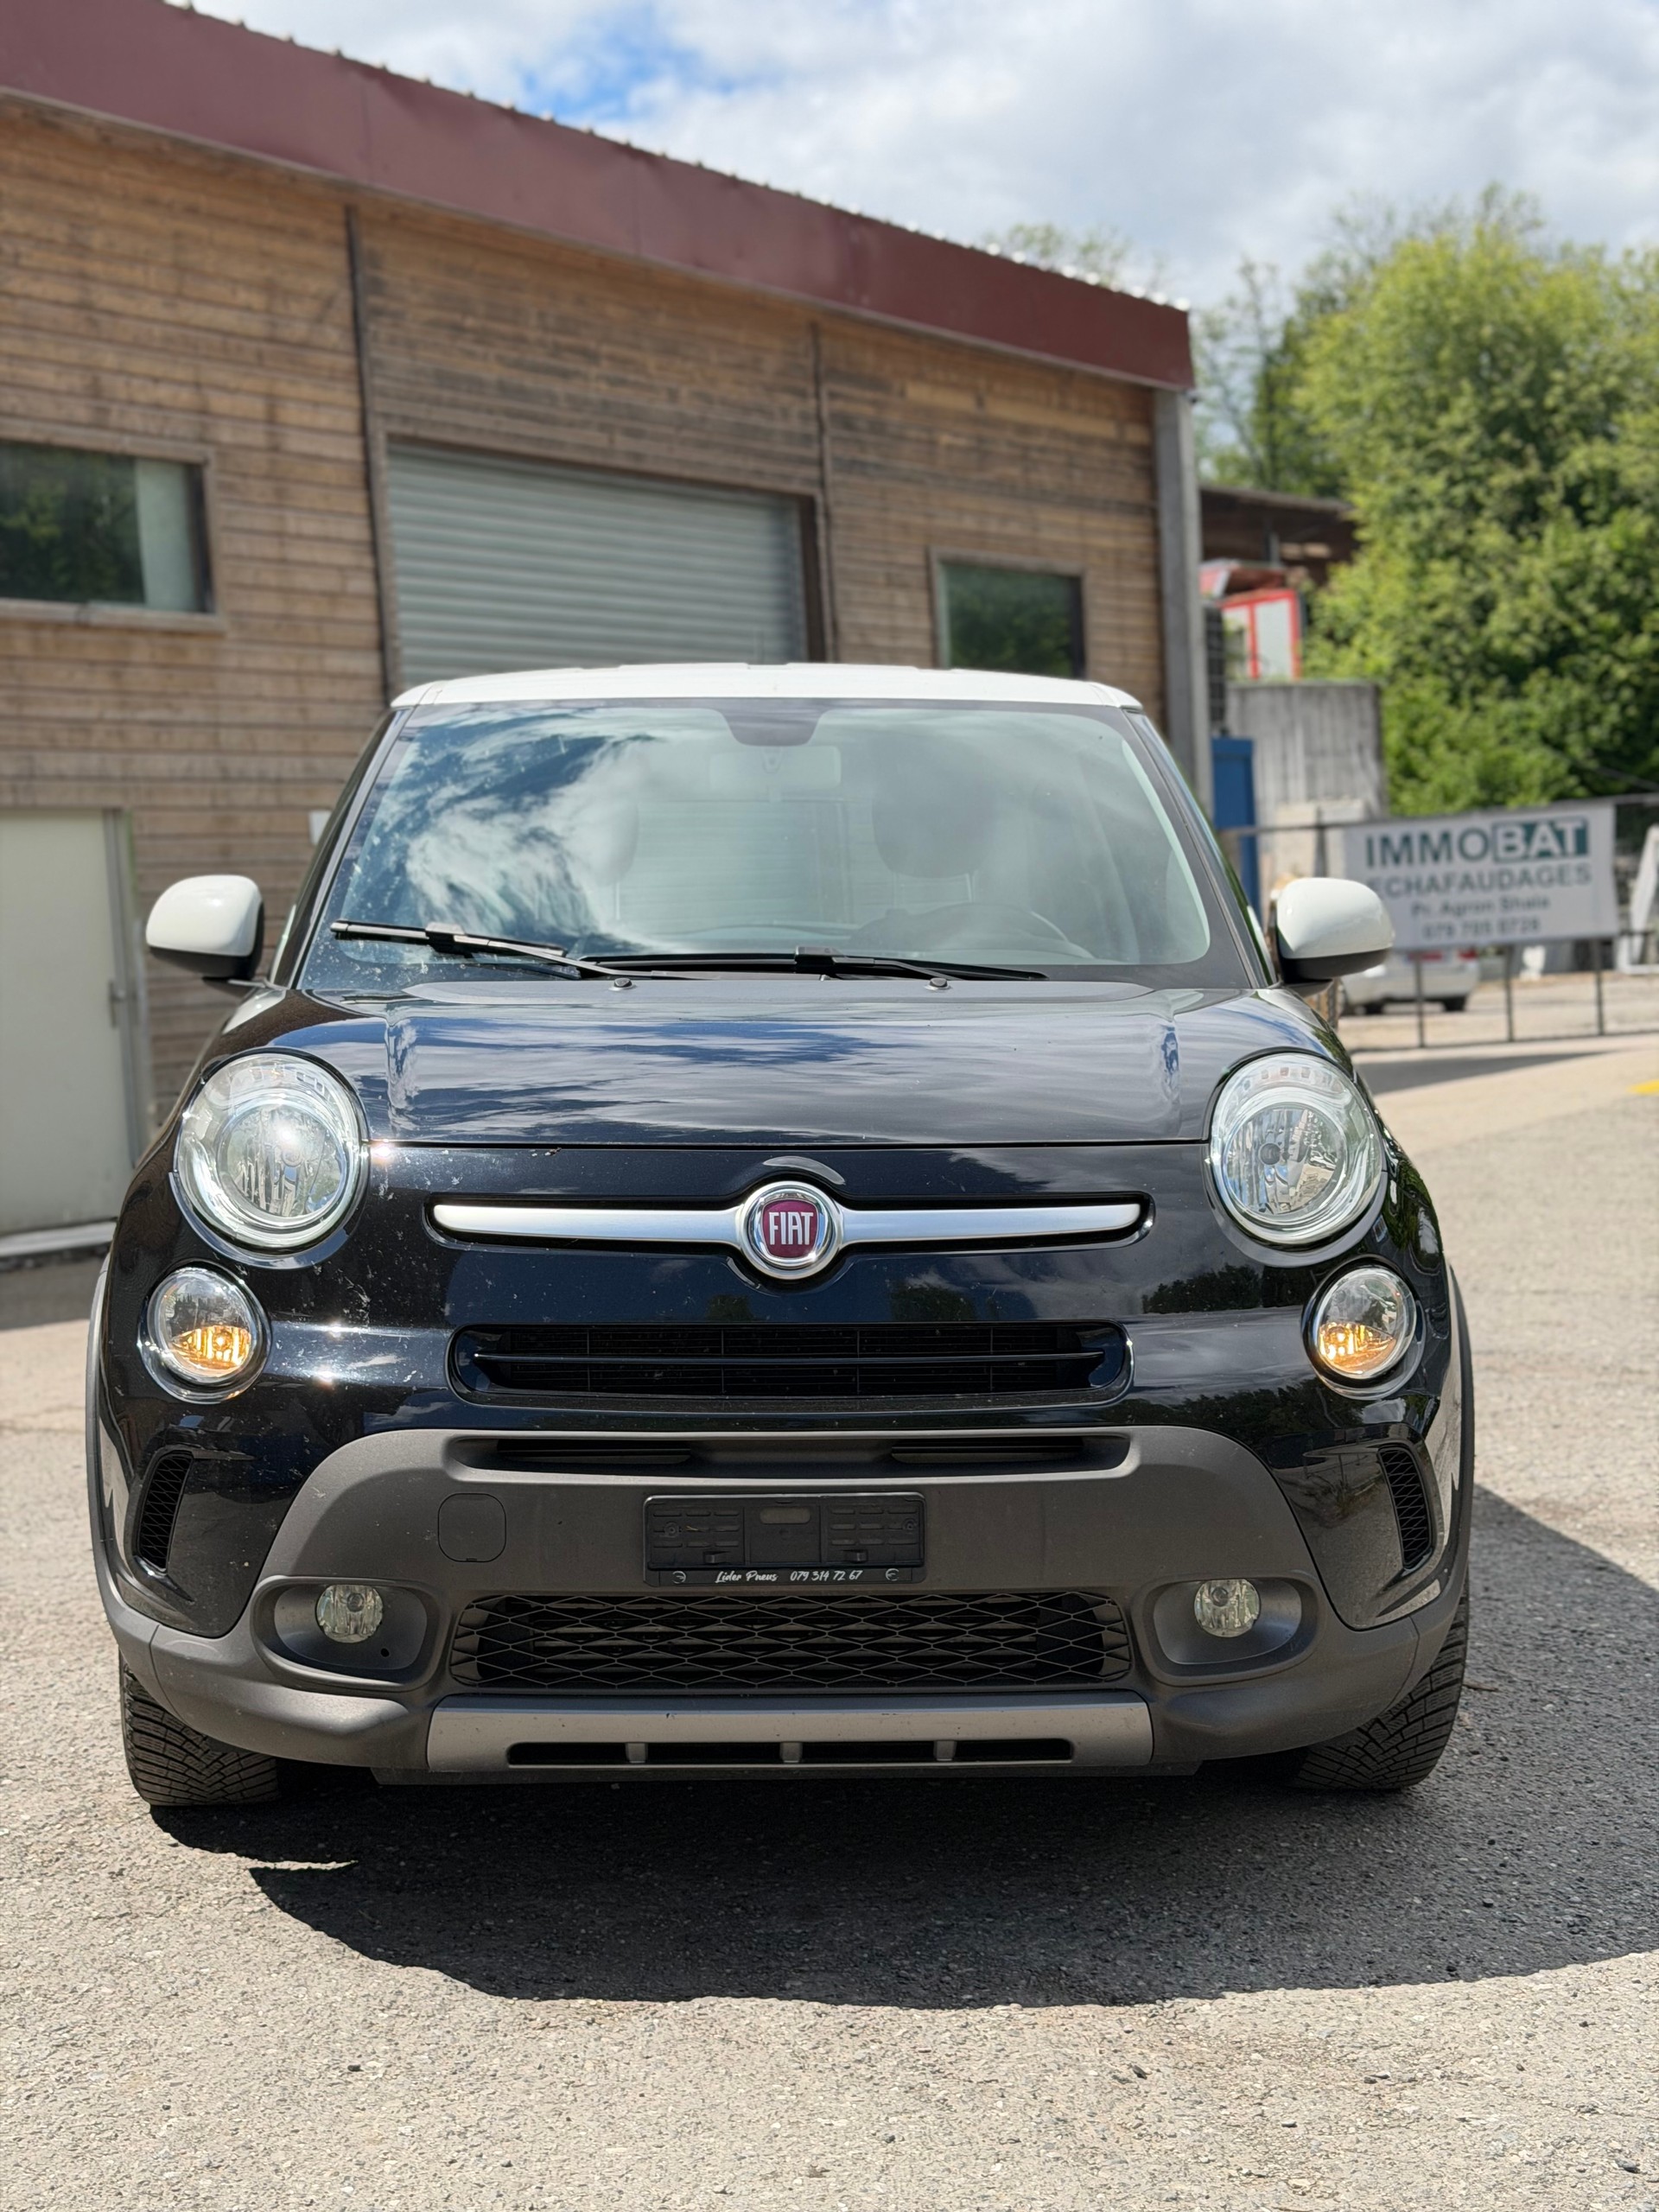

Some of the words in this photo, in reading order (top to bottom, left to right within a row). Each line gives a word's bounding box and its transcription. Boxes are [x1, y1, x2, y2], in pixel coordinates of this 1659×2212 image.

[1366, 816, 1590, 868] IMMOBAT
[768, 1211, 814, 1245] FIAT
[715, 1570, 742, 1584] Lider
[746, 1570, 779, 1582] Pneus
[790, 1571, 809, 1581] 079
[811, 1571, 830, 1581] 314
[833, 1570, 846, 1581] 72
[849, 1570, 863, 1580] 67
